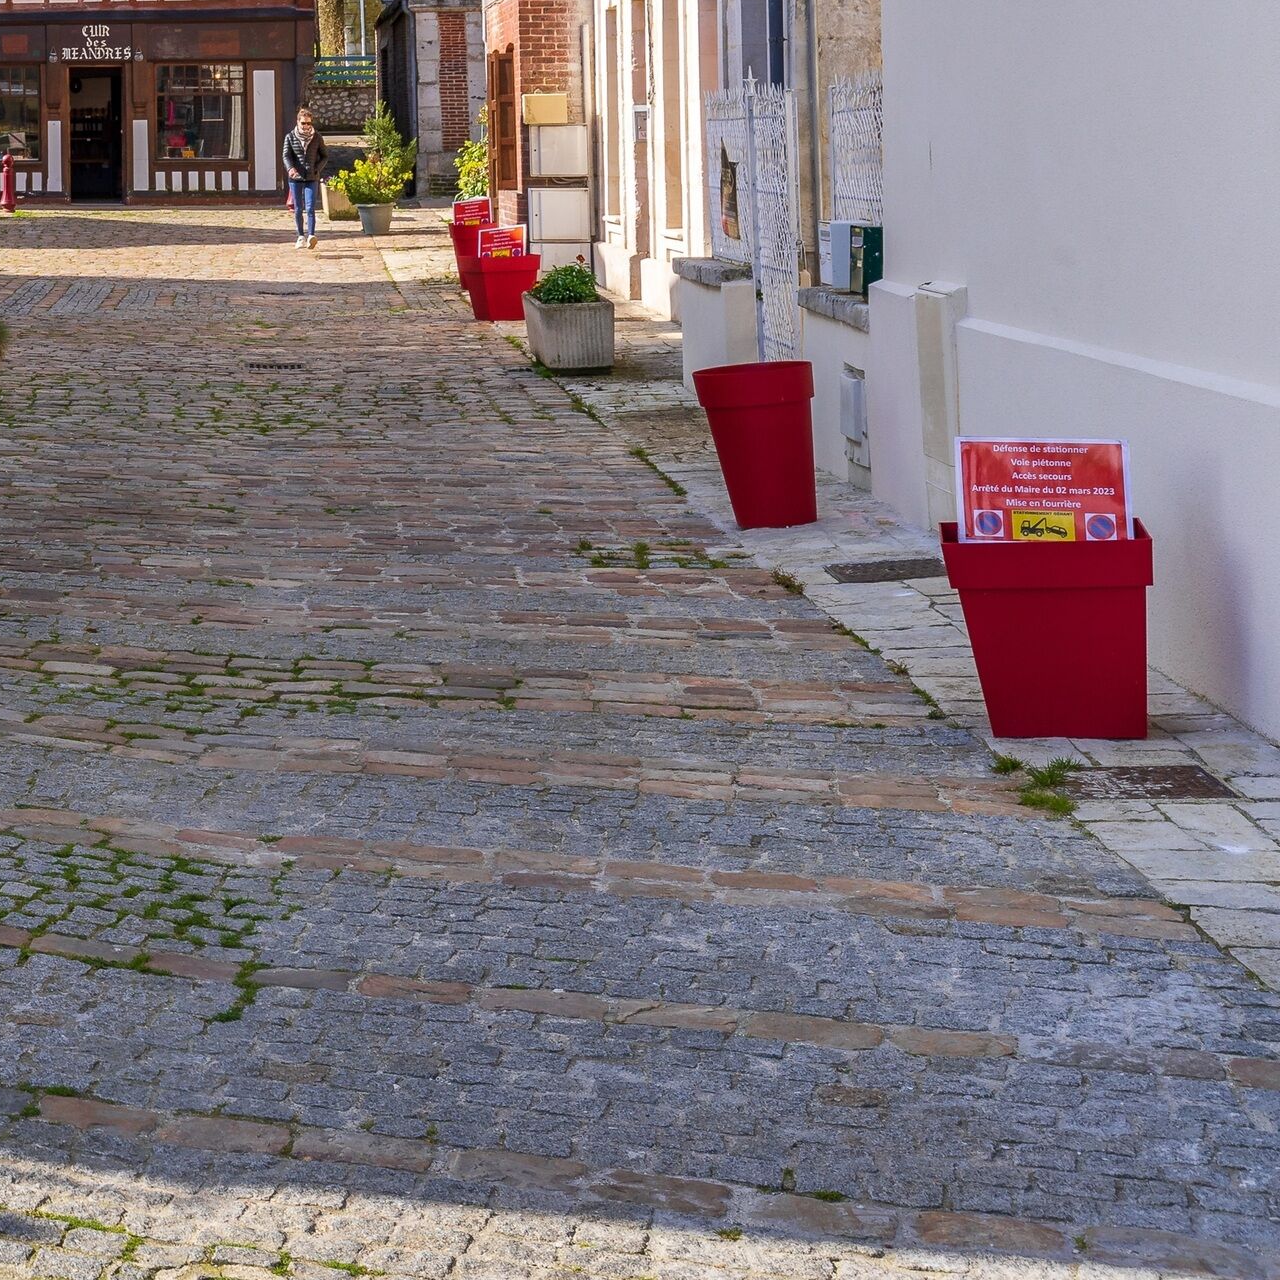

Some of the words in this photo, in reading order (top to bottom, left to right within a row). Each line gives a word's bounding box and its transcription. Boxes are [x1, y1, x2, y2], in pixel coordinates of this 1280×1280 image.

[81, 23, 110, 37] CUIR
[86, 37, 107, 48] des
[993, 444, 1028, 453] Défense
[1029, 445, 1041, 453] de
[1043, 445, 1089, 454] stationner
[1010, 458, 1030, 467] Voie
[1032, 458, 1072, 468] piétonne
[1011, 471, 1037, 480] Accès
[1038, 473, 1072, 481] secours
[971, 484, 1000, 492] Arrêté
[1001, 485, 1013, 493] du
[1014, 485, 1041, 493] Maire
[1042, 485, 1054, 494] du
[1055, 486, 1067, 494] 02
[1069, 487, 1091, 495] mars
[1093, 487, 1115, 495] 2023
[1005, 498, 1027, 507] Mise
[1042, 499, 1082, 508] fourrière
